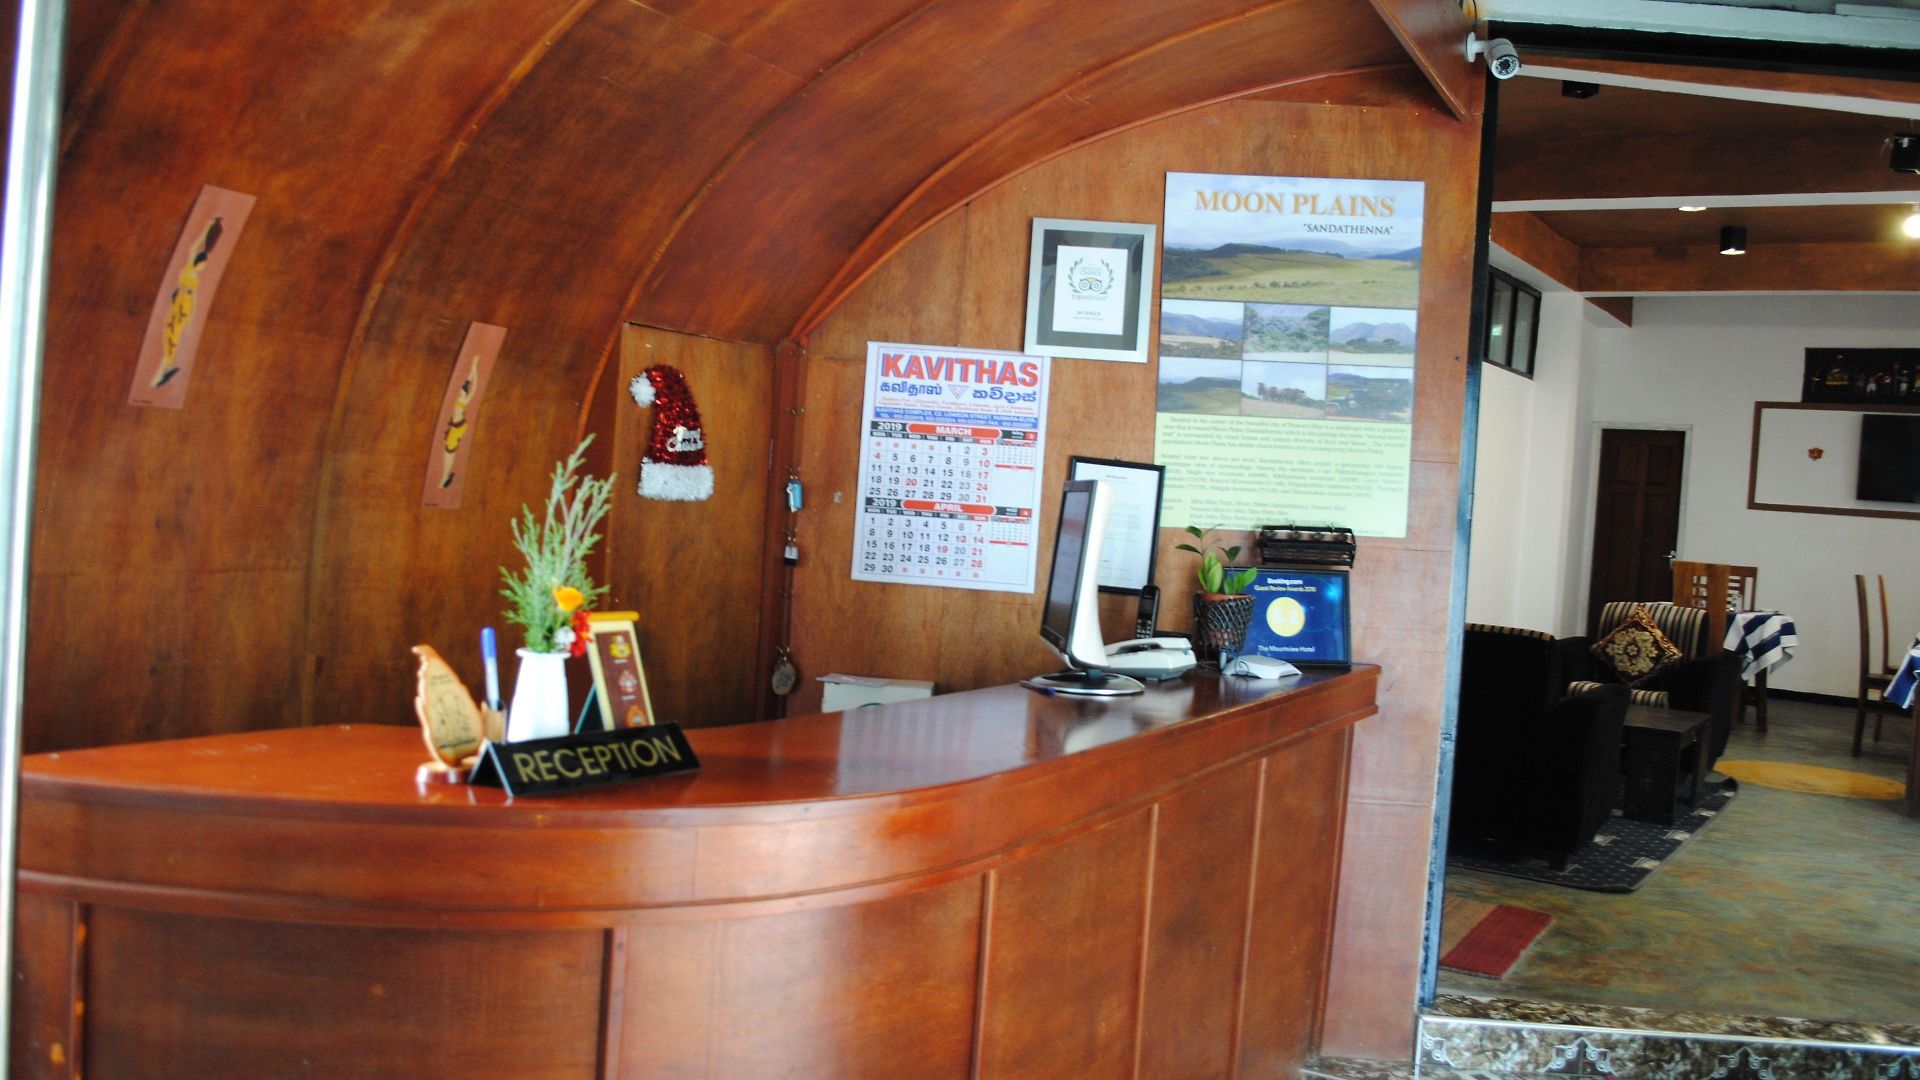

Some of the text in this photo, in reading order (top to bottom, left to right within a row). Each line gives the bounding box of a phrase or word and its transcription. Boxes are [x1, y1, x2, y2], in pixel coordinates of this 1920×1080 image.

[1194, 190, 1396, 218] MOON PLAINS
[881, 353, 1039, 388] KAVITHAS
[878, 422, 902, 431] 2019
[936, 426, 972, 436] MARCH
[963, 446, 970, 454] 2
[981, 447, 988, 456] 3
[891, 453, 898, 461] 5
[909, 454, 916, 462] 6
[927, 455, 934, 463] 7
[944, 456, 952, 465] 8
[962, 457, 970, 466] 9
[979, 459, 990, 467] 10
[889, 465, 900, 473] 12
[907, 466, 918, 474] 13
[942, 468, 953, 477] 15
[960, 470, 972, 478] 16
[978, 471, 988, 479] 17
[871, 475, 988, 491] 18 19 20 21 22 23 24
[868, 486, 986, 503] 25 26 27 28 29 30 31
[872, 500, 897, 508] 2019
[933, 502, 963, 512] APRIL
[887, 517, 894, 526] 2
[904, 519, 911, 527] 3
[940, 521, 947, 529] 5
[957, 523, 965, 531] 6
[976, 524, 982, 532] 7
[868, 528, 875, 536] 8
[886, 529, 893, 537] 9
[902, 531, 913, 539] 10
[938, 533, 948, 542] 12
[955, 534, 966, 543] 13
[866, 540, 877, 548] 15
[884, 541, 894, 550] 16
[919, 544, 930, 552] 18
[936, 545, 948, 553] 19
[954, 546, 966, 555] 20
[971, 547, 982, 555] 21
[864, 551, 982, 567] 22 23 24 25 26 27 28
[864, 563, 893, 573] 29 30
[513, 735, 682, 784] RECEPTION
